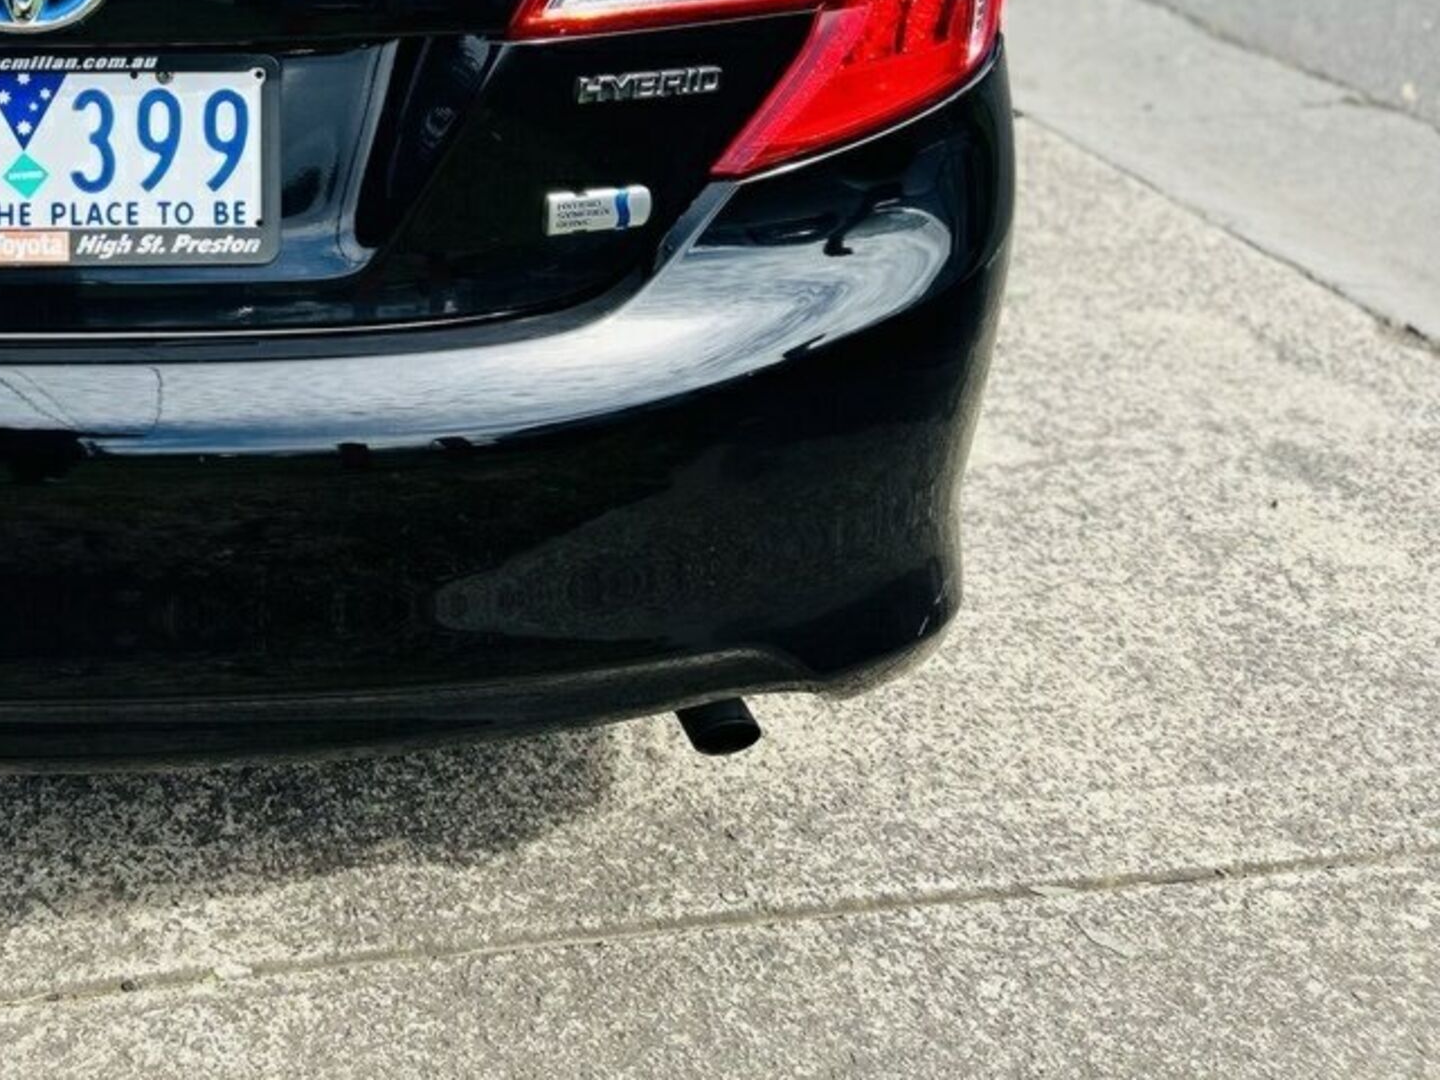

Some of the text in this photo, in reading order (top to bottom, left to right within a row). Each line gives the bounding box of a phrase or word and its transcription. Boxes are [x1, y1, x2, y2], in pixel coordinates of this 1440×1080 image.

[577, 64, 723, 104] HYBRID
[70, 88, 249, 193] 399
[50, 201, 139, 226] PLACE
[156, 201, 194, 225] TO
[213, 200, 247, 225] BE
[76, 233, 134, 259] High
[135, 234, 167, 254] St.
[170, 234, 262, 255] Preston
